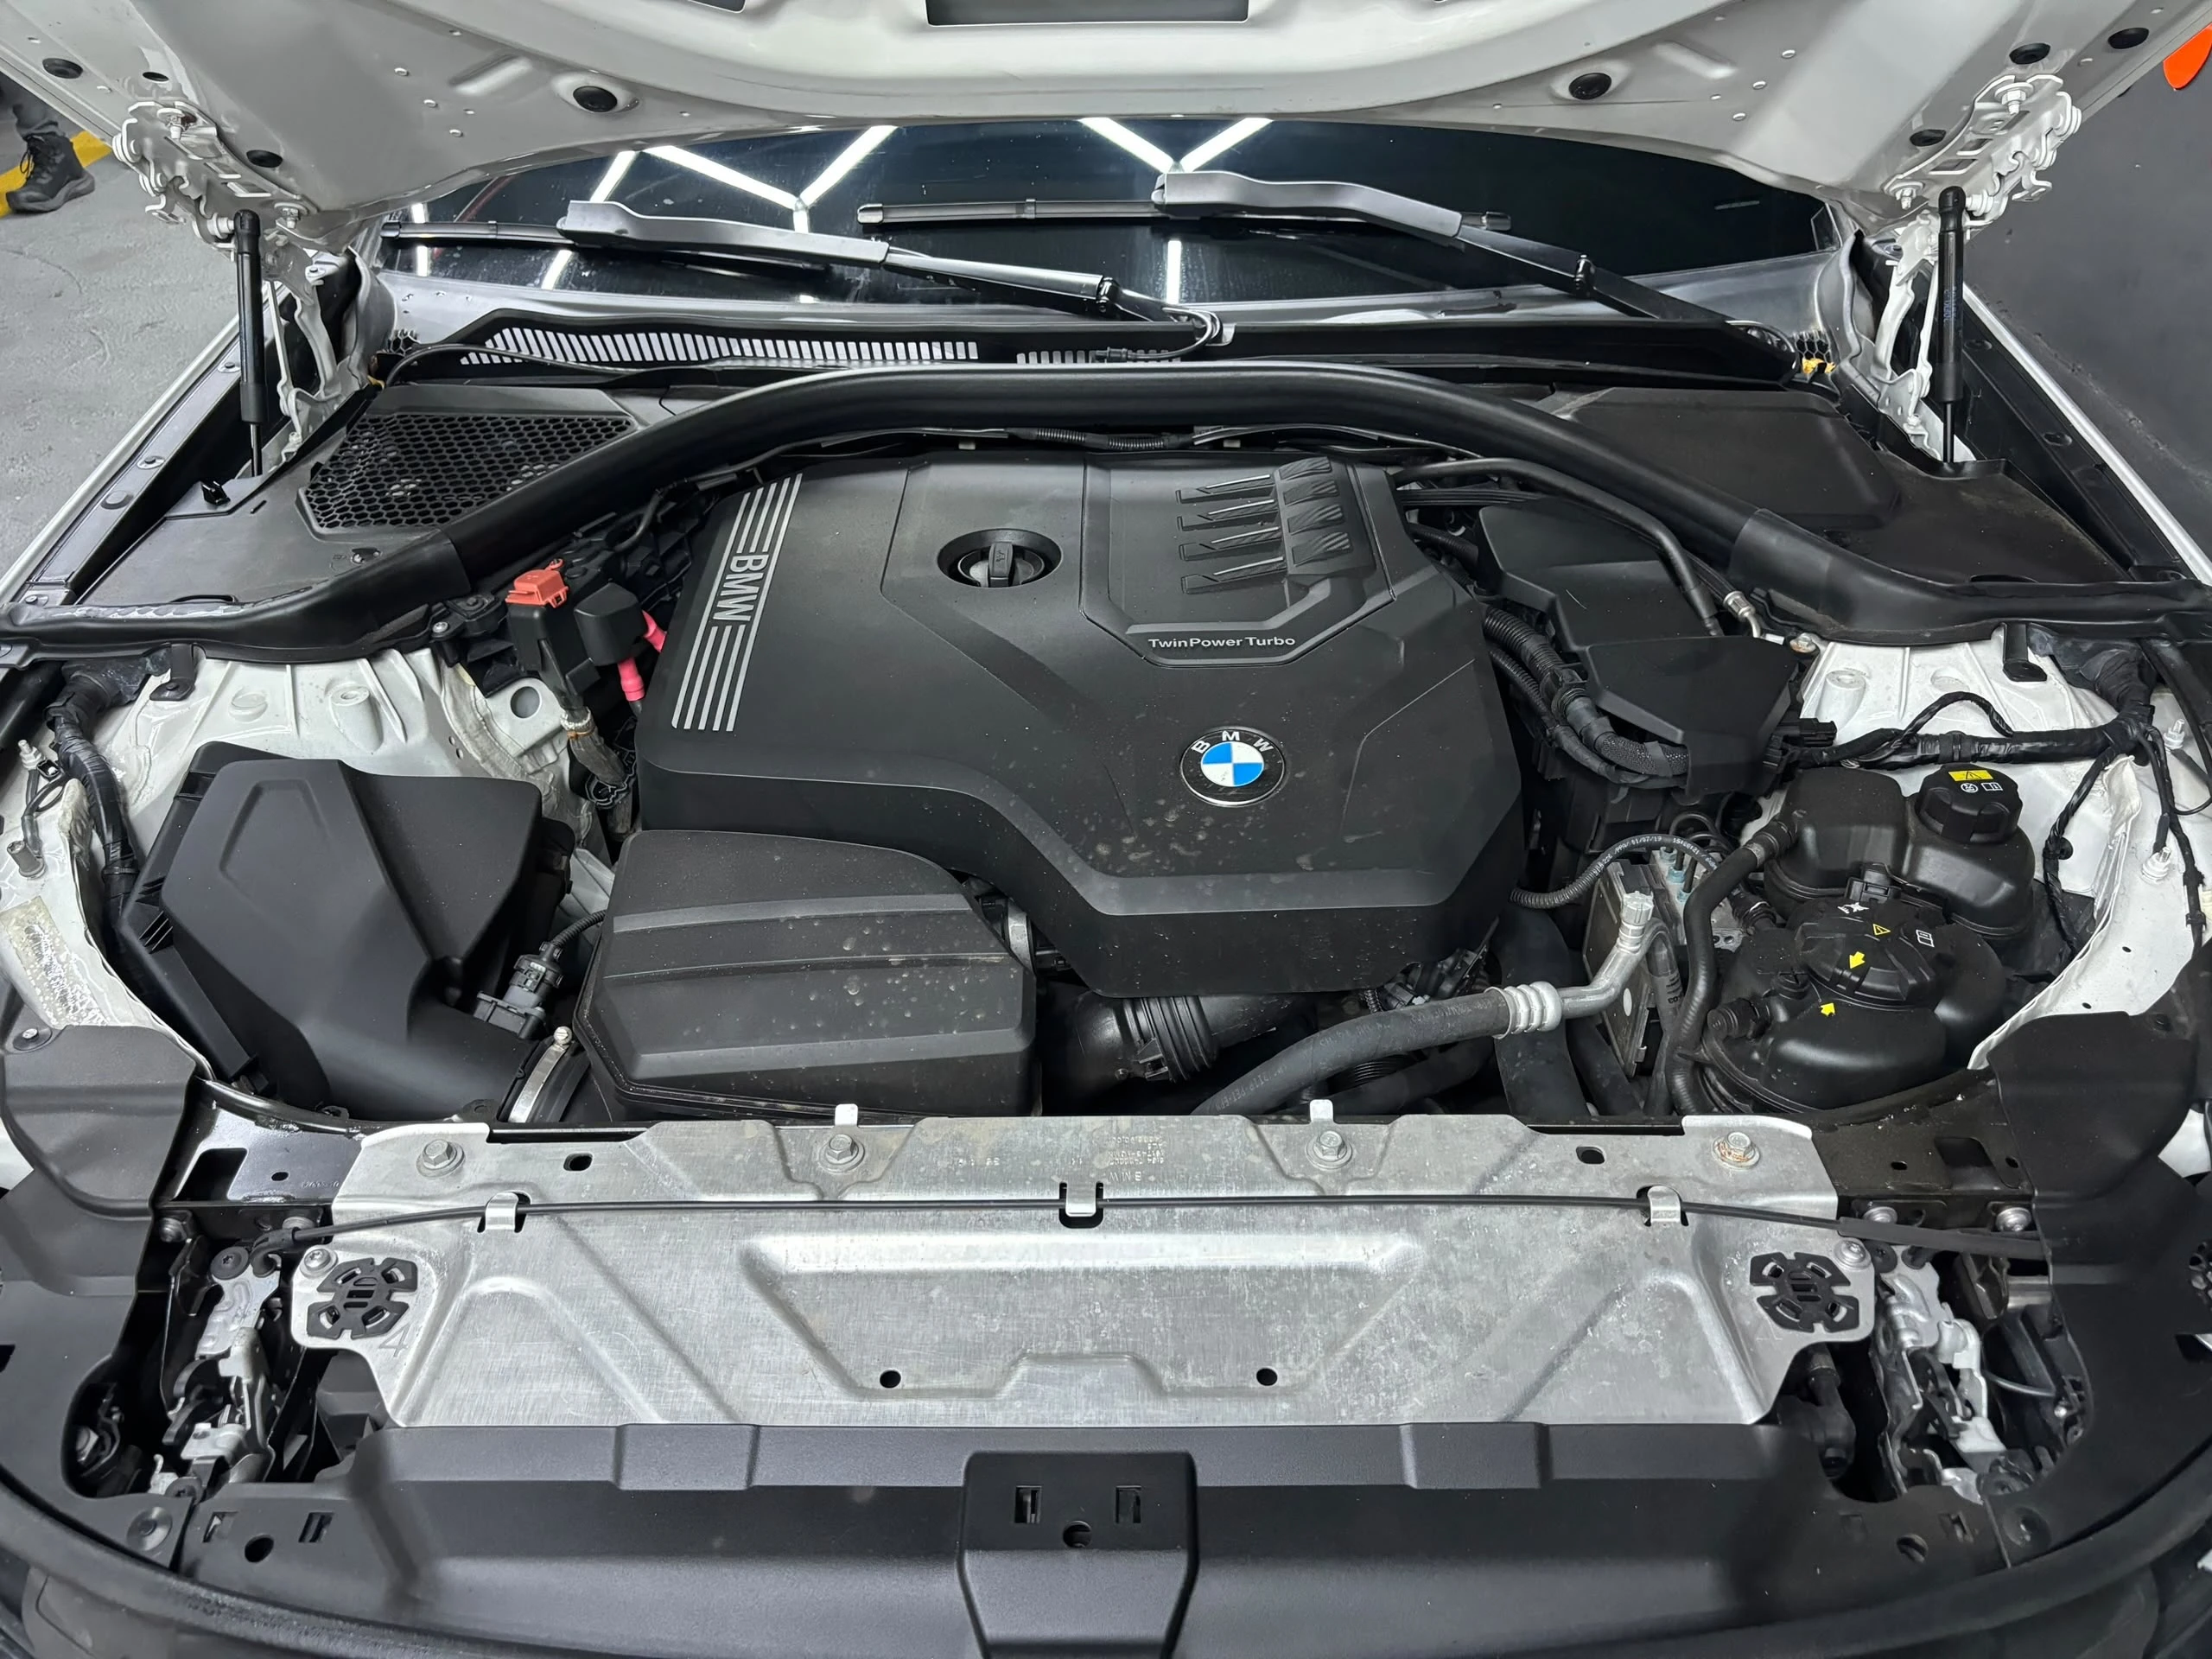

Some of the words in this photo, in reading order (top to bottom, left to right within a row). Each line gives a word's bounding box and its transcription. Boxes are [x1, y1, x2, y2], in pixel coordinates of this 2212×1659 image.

[712, 554, 770, 622] BMW
[1147, 637, 1243, 648] TwinPower
[1244, 636, 1296, 647] Turbo
[1191, 730, 1274, 754] BMW
